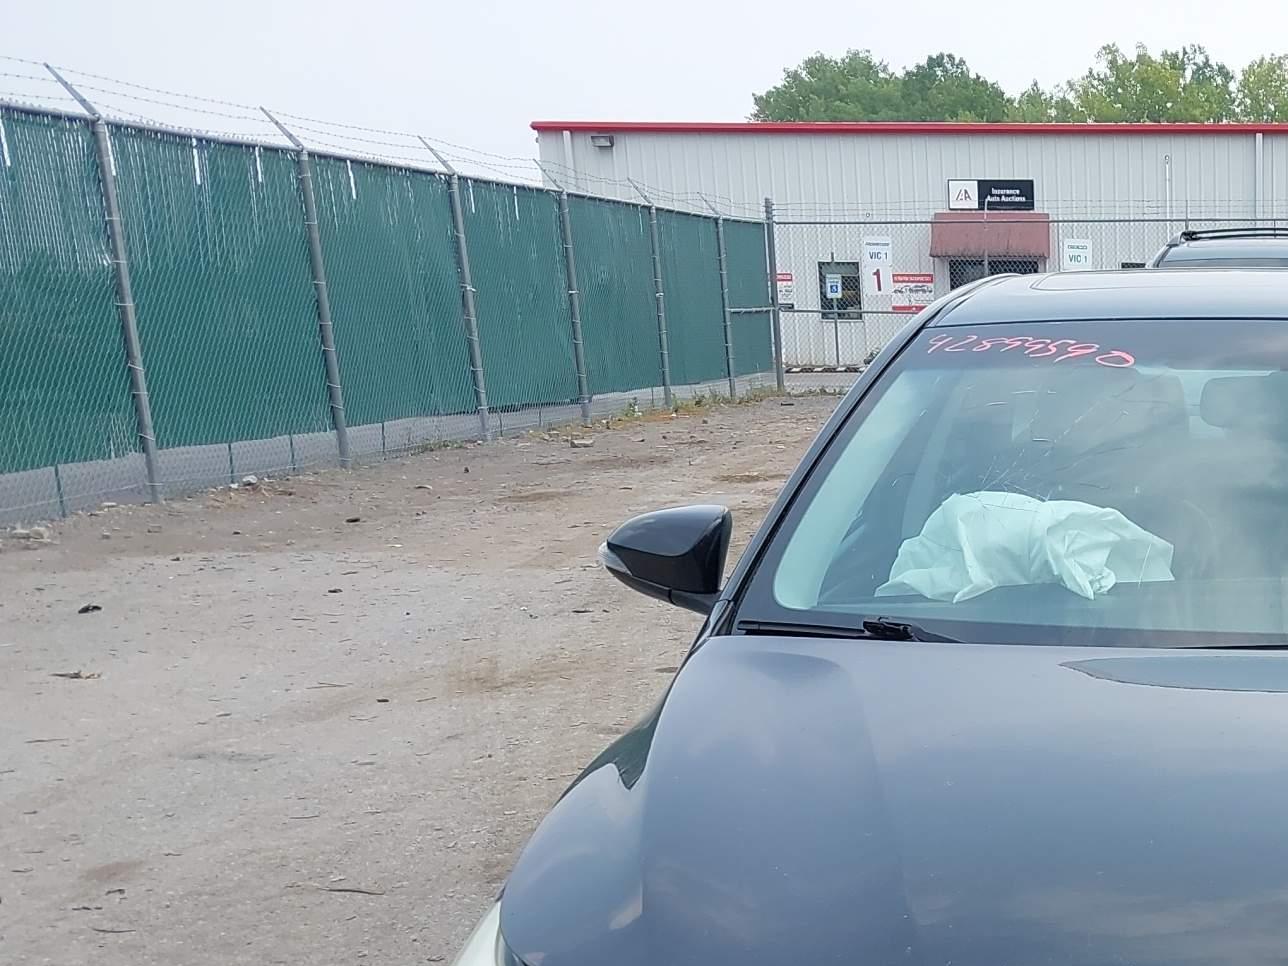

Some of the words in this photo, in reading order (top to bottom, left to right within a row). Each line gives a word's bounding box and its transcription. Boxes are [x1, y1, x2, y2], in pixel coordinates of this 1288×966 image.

[991, 187, 1020, 195] Insurance
[1001, 194, 1026, 202] Auctions
[868, 251, 882, 260] VIC
[1068, 254, 1082, 263] VIC
[872, 268, 882, 292] 1
[927, 333, 1135, 368] 42899590
